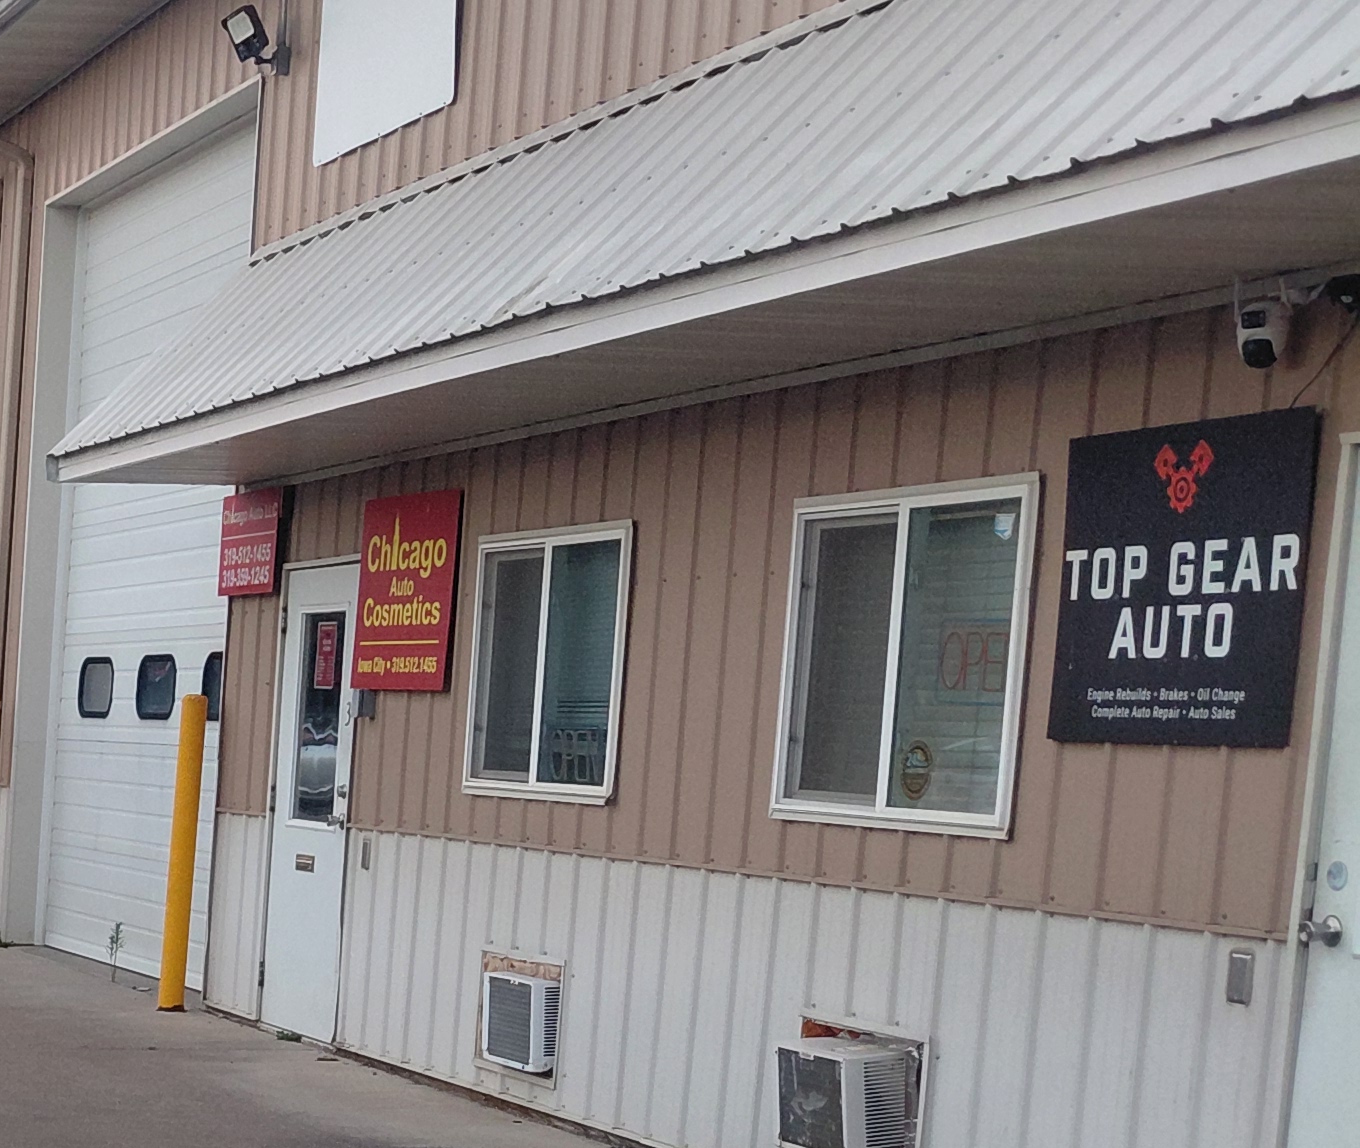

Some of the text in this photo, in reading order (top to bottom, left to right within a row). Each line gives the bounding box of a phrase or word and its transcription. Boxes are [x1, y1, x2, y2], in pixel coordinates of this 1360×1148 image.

[367, 513, 447, 578] Chicago
[1066, 533, 1300, 601] TOP GEAR
[389, 576, 414, 597] Auto
[363, 595, 441, 627] Cosmetics
[1108, 602, 1233, 659] AUTO
[357, 657, 372, 673] Iowa
[373, 657, 386, 676] City
[1087, 687, 1246, 704] Engine Rebuilds Brakes Oil Change
[1091, 705, 1236, 721] Complete Auto Repair Auto Sales
